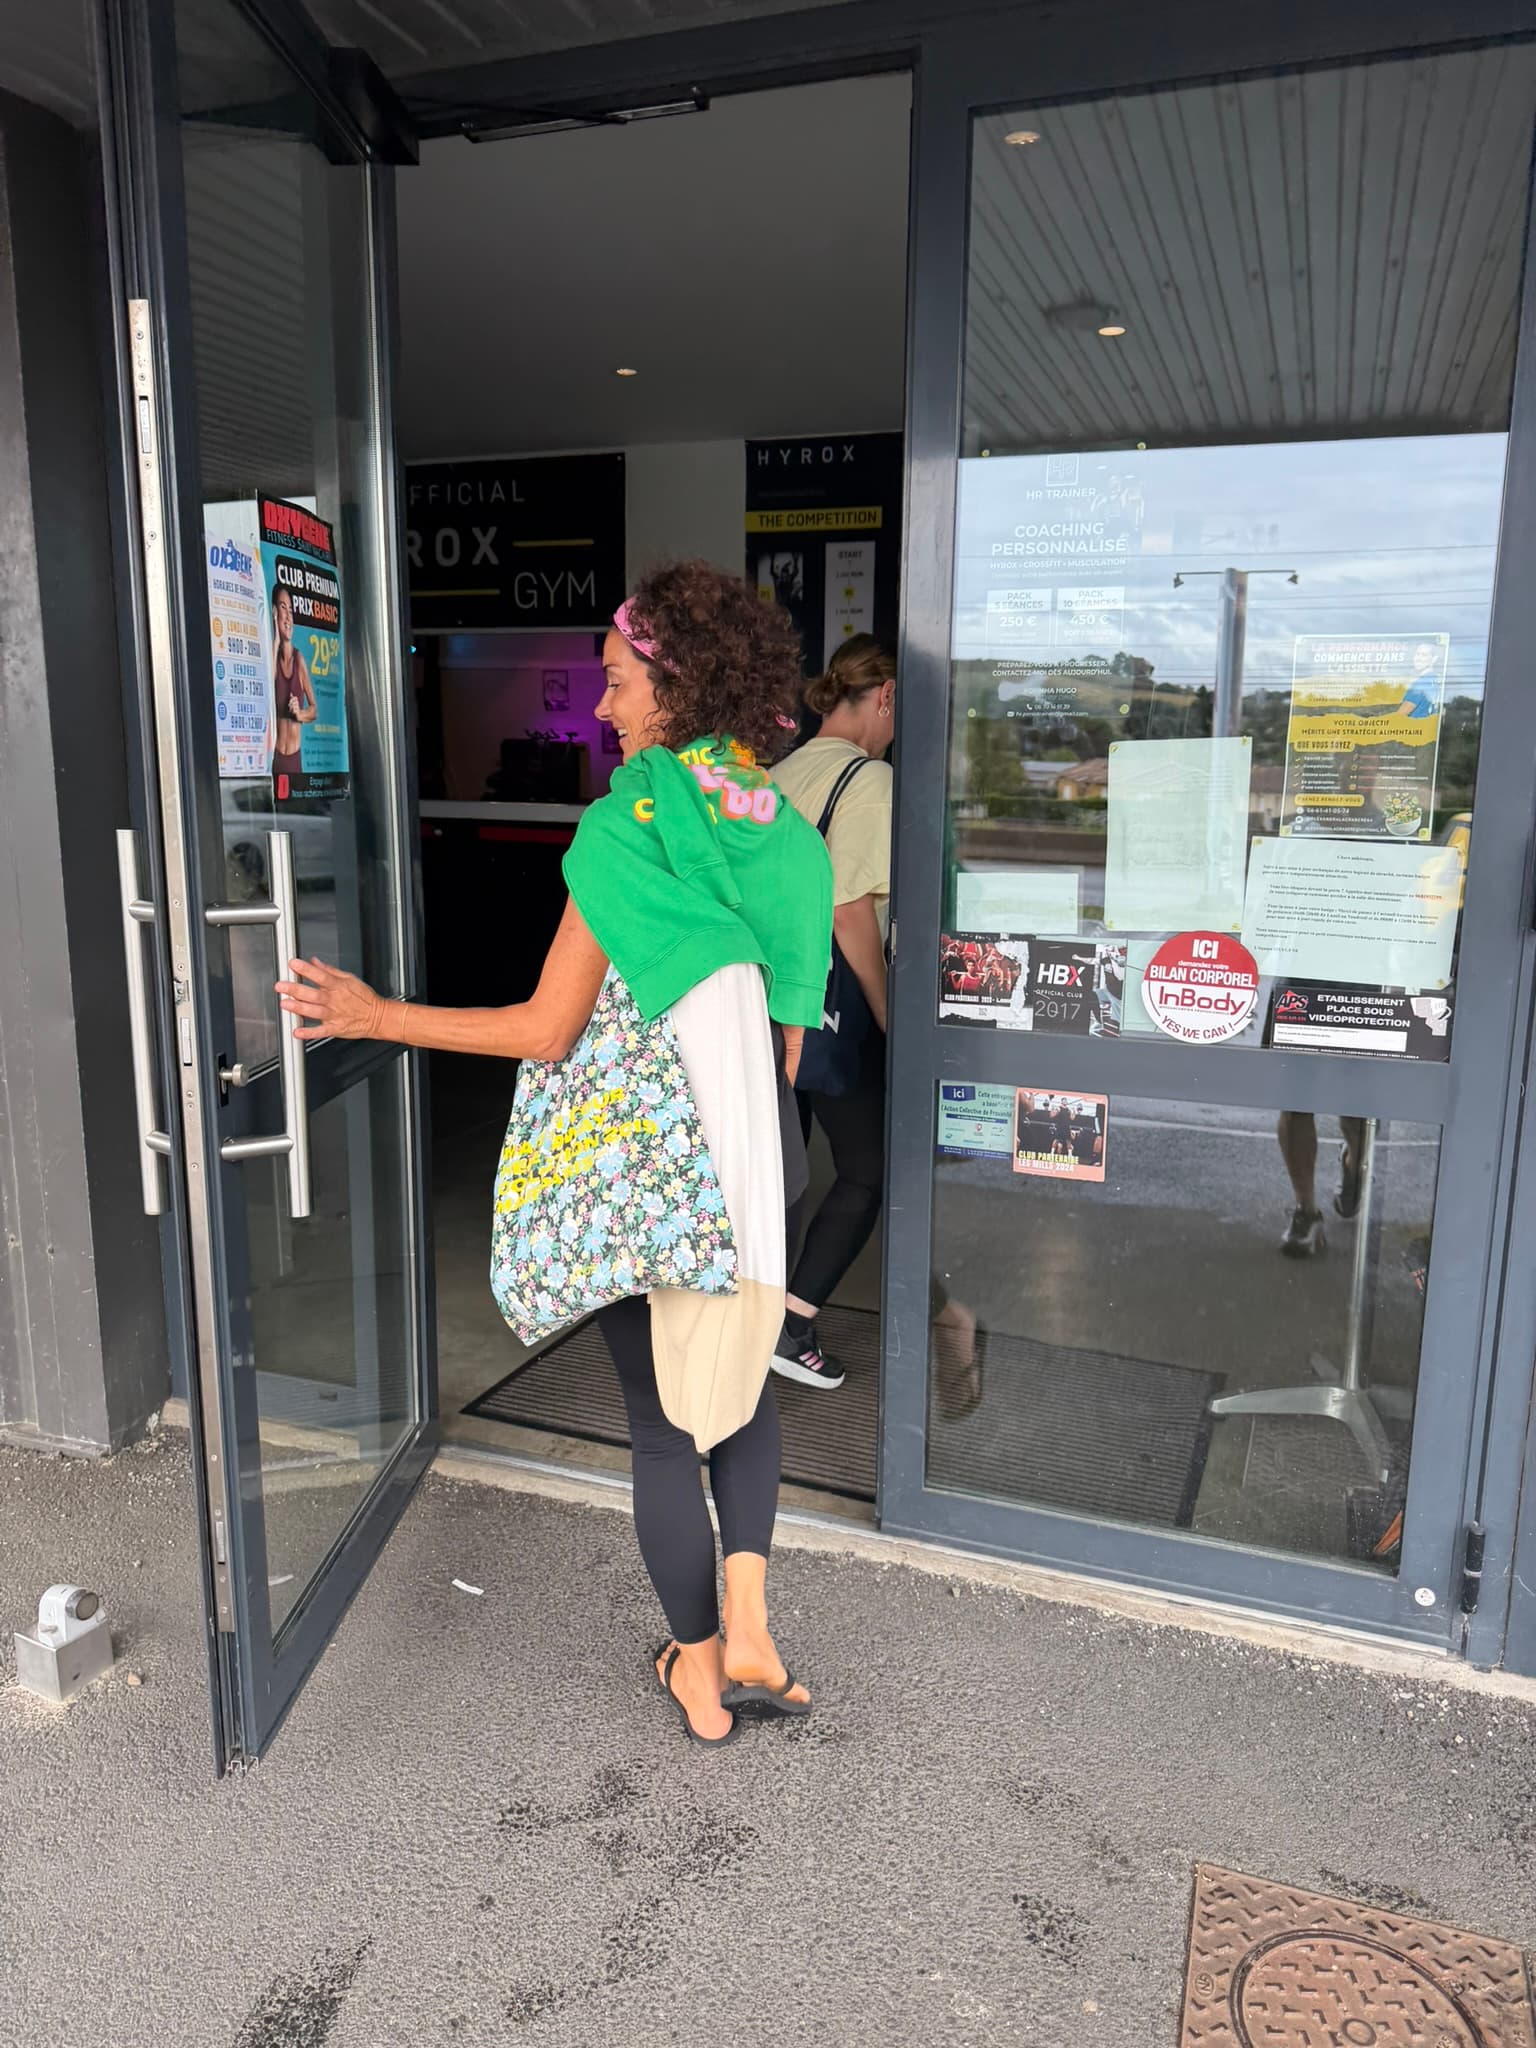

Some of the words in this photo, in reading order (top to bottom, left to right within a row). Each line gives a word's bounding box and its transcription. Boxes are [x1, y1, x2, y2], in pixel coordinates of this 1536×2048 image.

[757, 445, 855, 466] HYROX
[409, 480, 526, 506] FFICIAL
[1046, 487, 1097, 499] TRAINER
[759, 514, 782, 528] THE
[787, 510, 877, 526] COMPETITION
[267, 529, 296, 548] FITNESS
[1015, 522, 1104, 538] COACHING
[407, 526, 500, 568] ROX
[991, 533, 1128, 555] PERSONNALISÉ
[838, 550, 863, 559] START
[278, 564, 303, 589] CLUB
[305, 571, 339, 600] PREMIUM
[514, 570, 596, 609] GYM
[1007, 591, 1032, 601] PACK
[293, 595, 313, 615] PRIX
[314, 601, 338, 624] BASIC
[999, 616, 1024, 627] 250
[1027, 615, 1038, 625] €
[1314, 653, 1371, 663] COMMENCE
[1376, 652, 1405, 662] DANS
[1192, 939, 1219, 959] ICI
[1178, 960, 1211, 968] demandez
[1037, 963, 1085, 987] HBX
[1150, 965, 1186, 981] BILAN
[1190, 969, 1256, 987] CORPOREL
[1033, 988, 1066, 998] OFFICIAL
[1159, 986, 1246, 1016] InBody
[1317, 994, 1405, 1006] ETABLISSEMENT
[1034, 1000, 1080, 1021] 2017
[1276, 994, 1309, 1010] APS
[1327, 1005, 1361, 1014] PLACE
[1364, 1008, 1394, 1016] SOUS
[1161, 1015, 1182, 1033] YES
[1182, 1027, 1200, 1039] WE
[1203, 1025, 1227, 1039] CAN
[1309, 1014, 1411, 1027] VIDEOPROTECTION
[953, 1088, 965, 1098] ici
[959, 1106, 982, 1115] Collective
[1018, 1150, 1036, 1160] CLUB
[1037, 1152, 1079, 1164] PARTENAIRE
